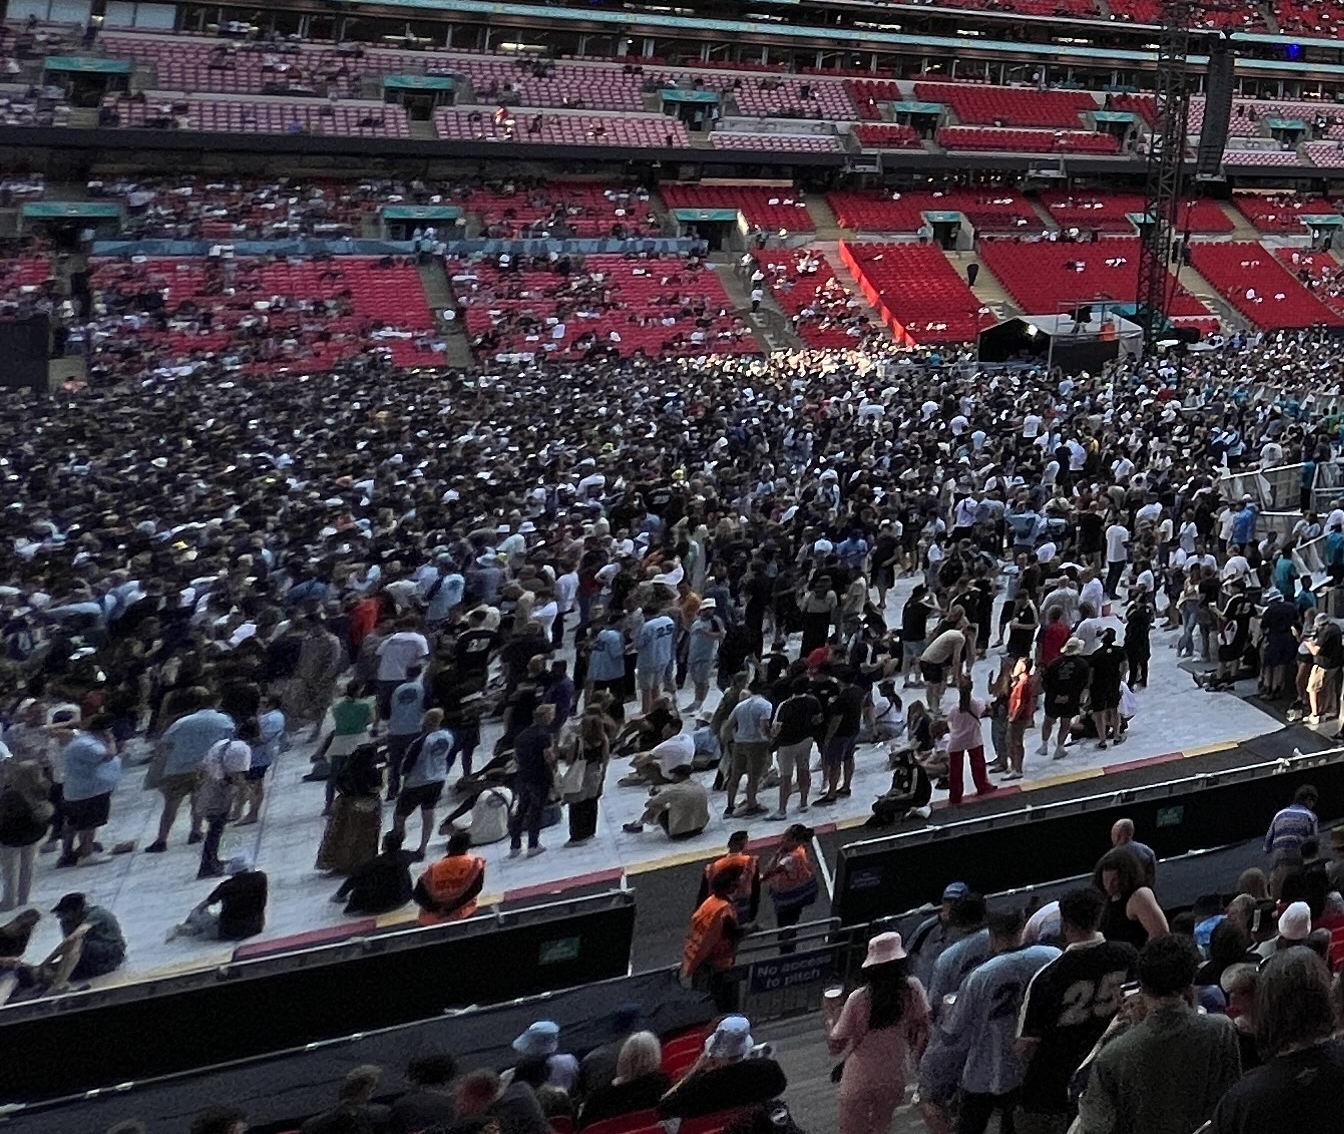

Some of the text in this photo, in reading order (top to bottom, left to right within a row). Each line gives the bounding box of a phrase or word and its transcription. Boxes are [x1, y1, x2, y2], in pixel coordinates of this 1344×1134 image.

[757, 954, 832, 977] No access
[784, 968, 820, 985] pitch
[1056, 970, 1129, 1027] 25
